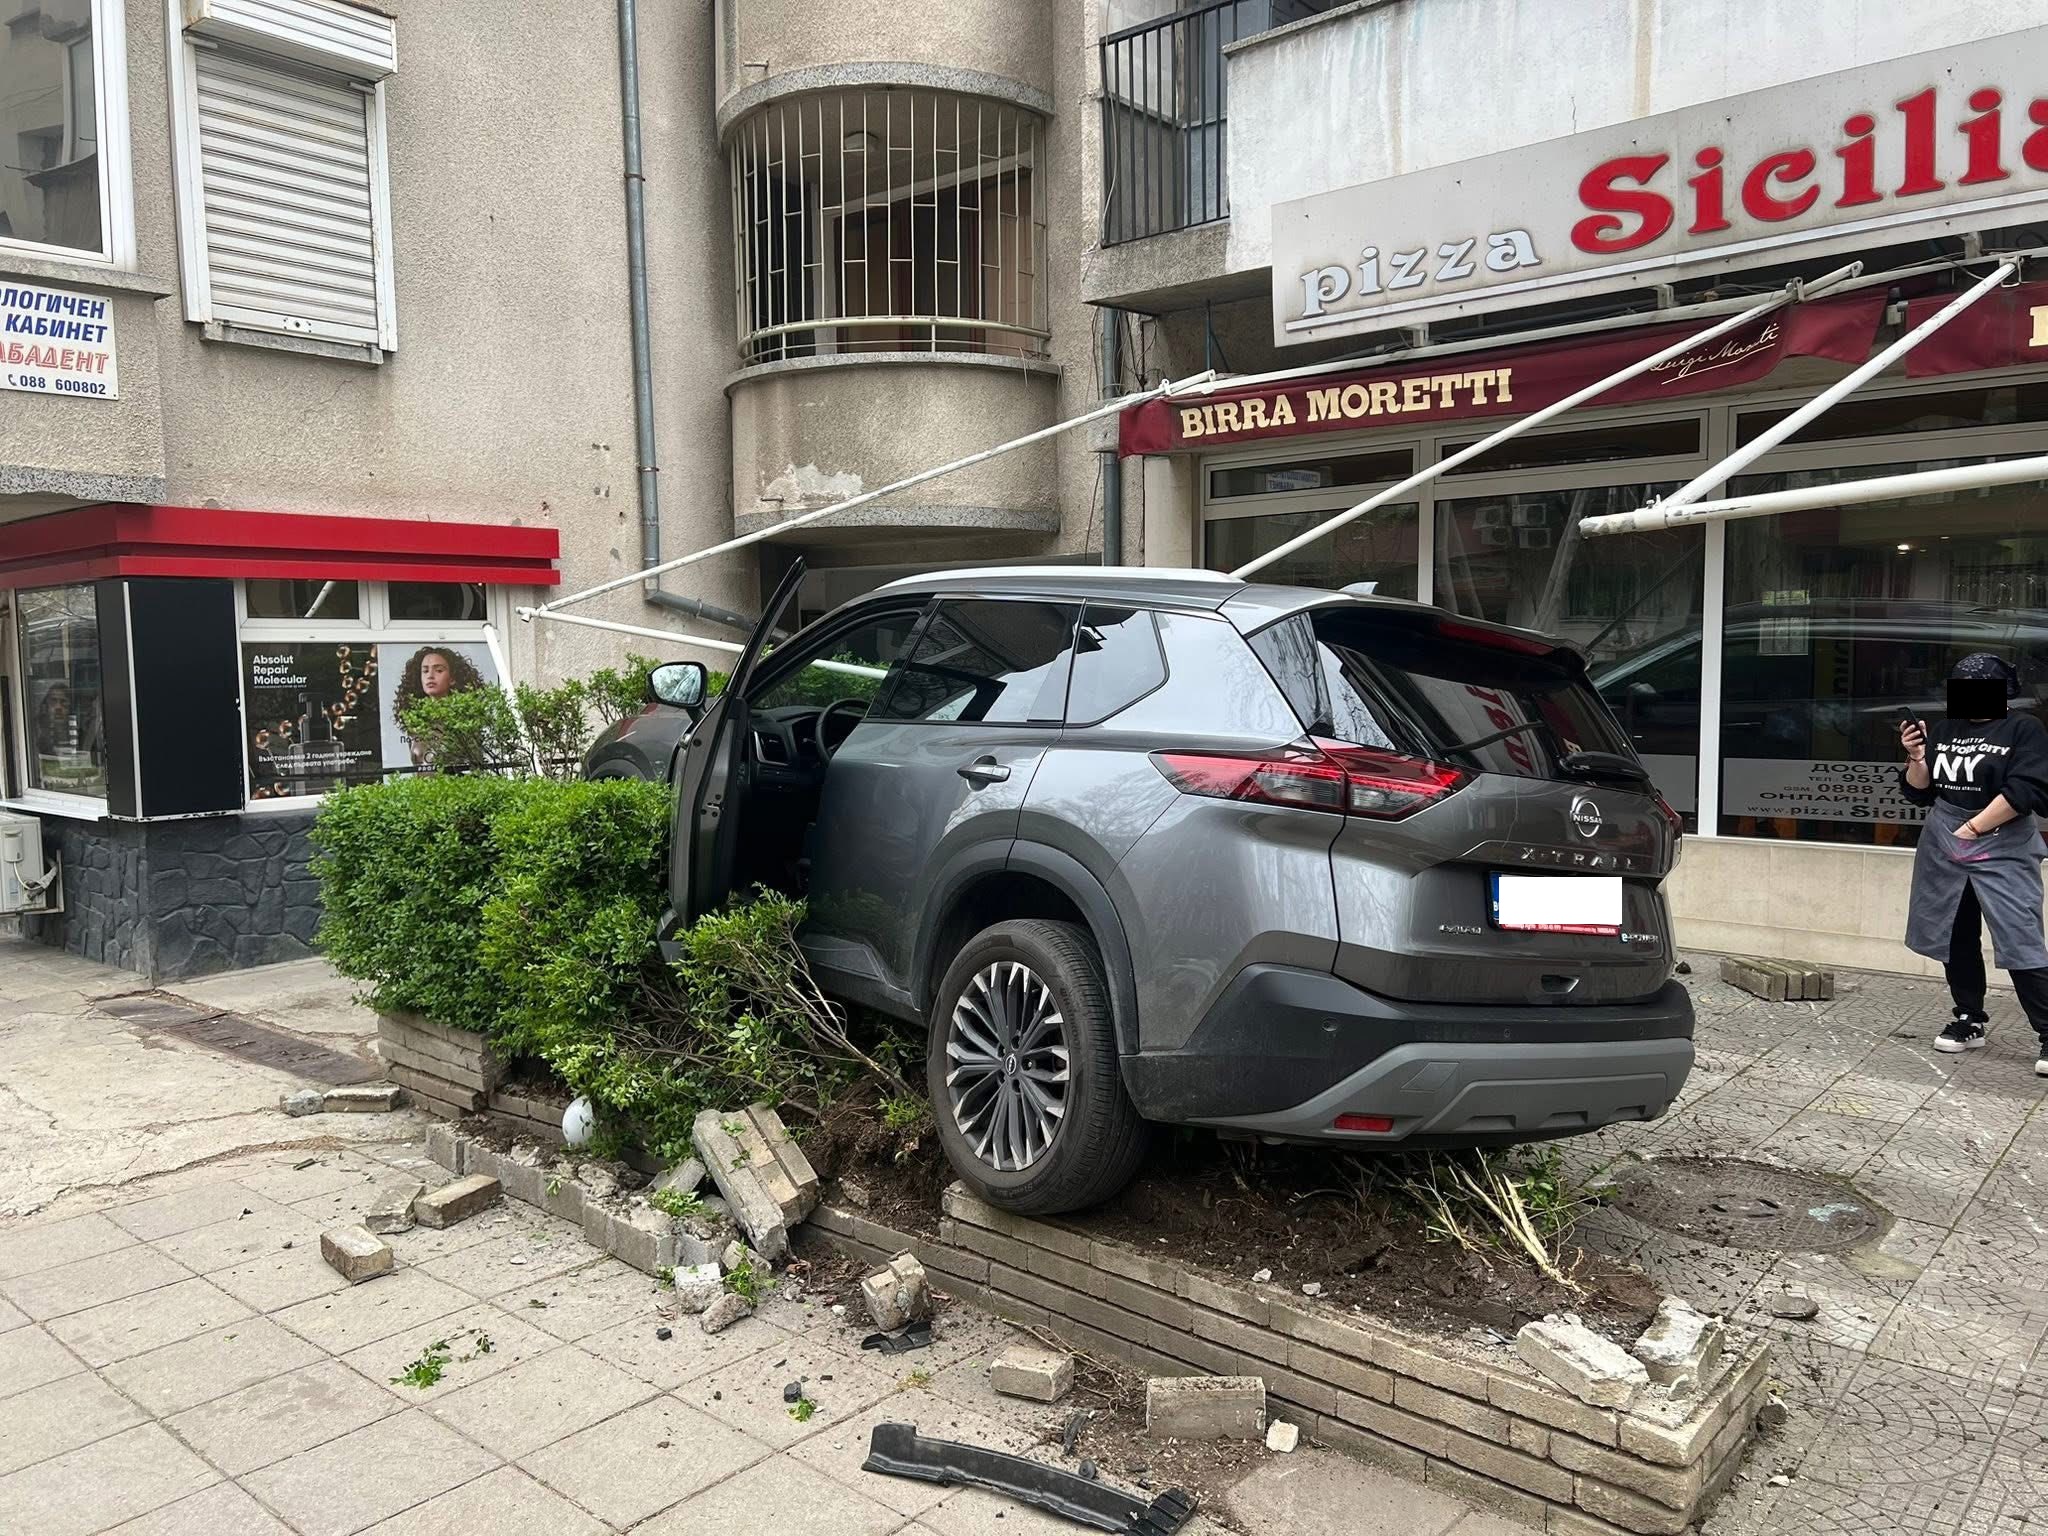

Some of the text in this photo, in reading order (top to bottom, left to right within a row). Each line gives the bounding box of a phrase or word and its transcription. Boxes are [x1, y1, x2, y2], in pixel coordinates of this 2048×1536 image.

[1300, 228, 1541, 319] pizza
[0, 288, 105, 320] ЛОГИЧЕН
[5, 313, 108, 343] КАБИНЕТ
[20, 375, 107, 395] 088 600802
[1181, 367, 1513, 438] BIRRA MORETTI
[253, 654, 294, 664] Absolut
[253, 665, 289, 676] Repair
[254, 674, 308, 685] Molecular
[1978, 743, 2011, 756] CITY
[306, 752, 311, 760] 2
[1811, 763, 1902, 774] ДОСТА
[1933, 753, 1986, 782] NY
[1842, 774, 1885, 784] 953
[1817, 784, 1875, 795] 0888
[1759, 792, 1869, 804] ОНЛАЙН
[1572, 813, 1602, 825] NISSAN
[1520, 847, 1636, 870] X-TRAIL
